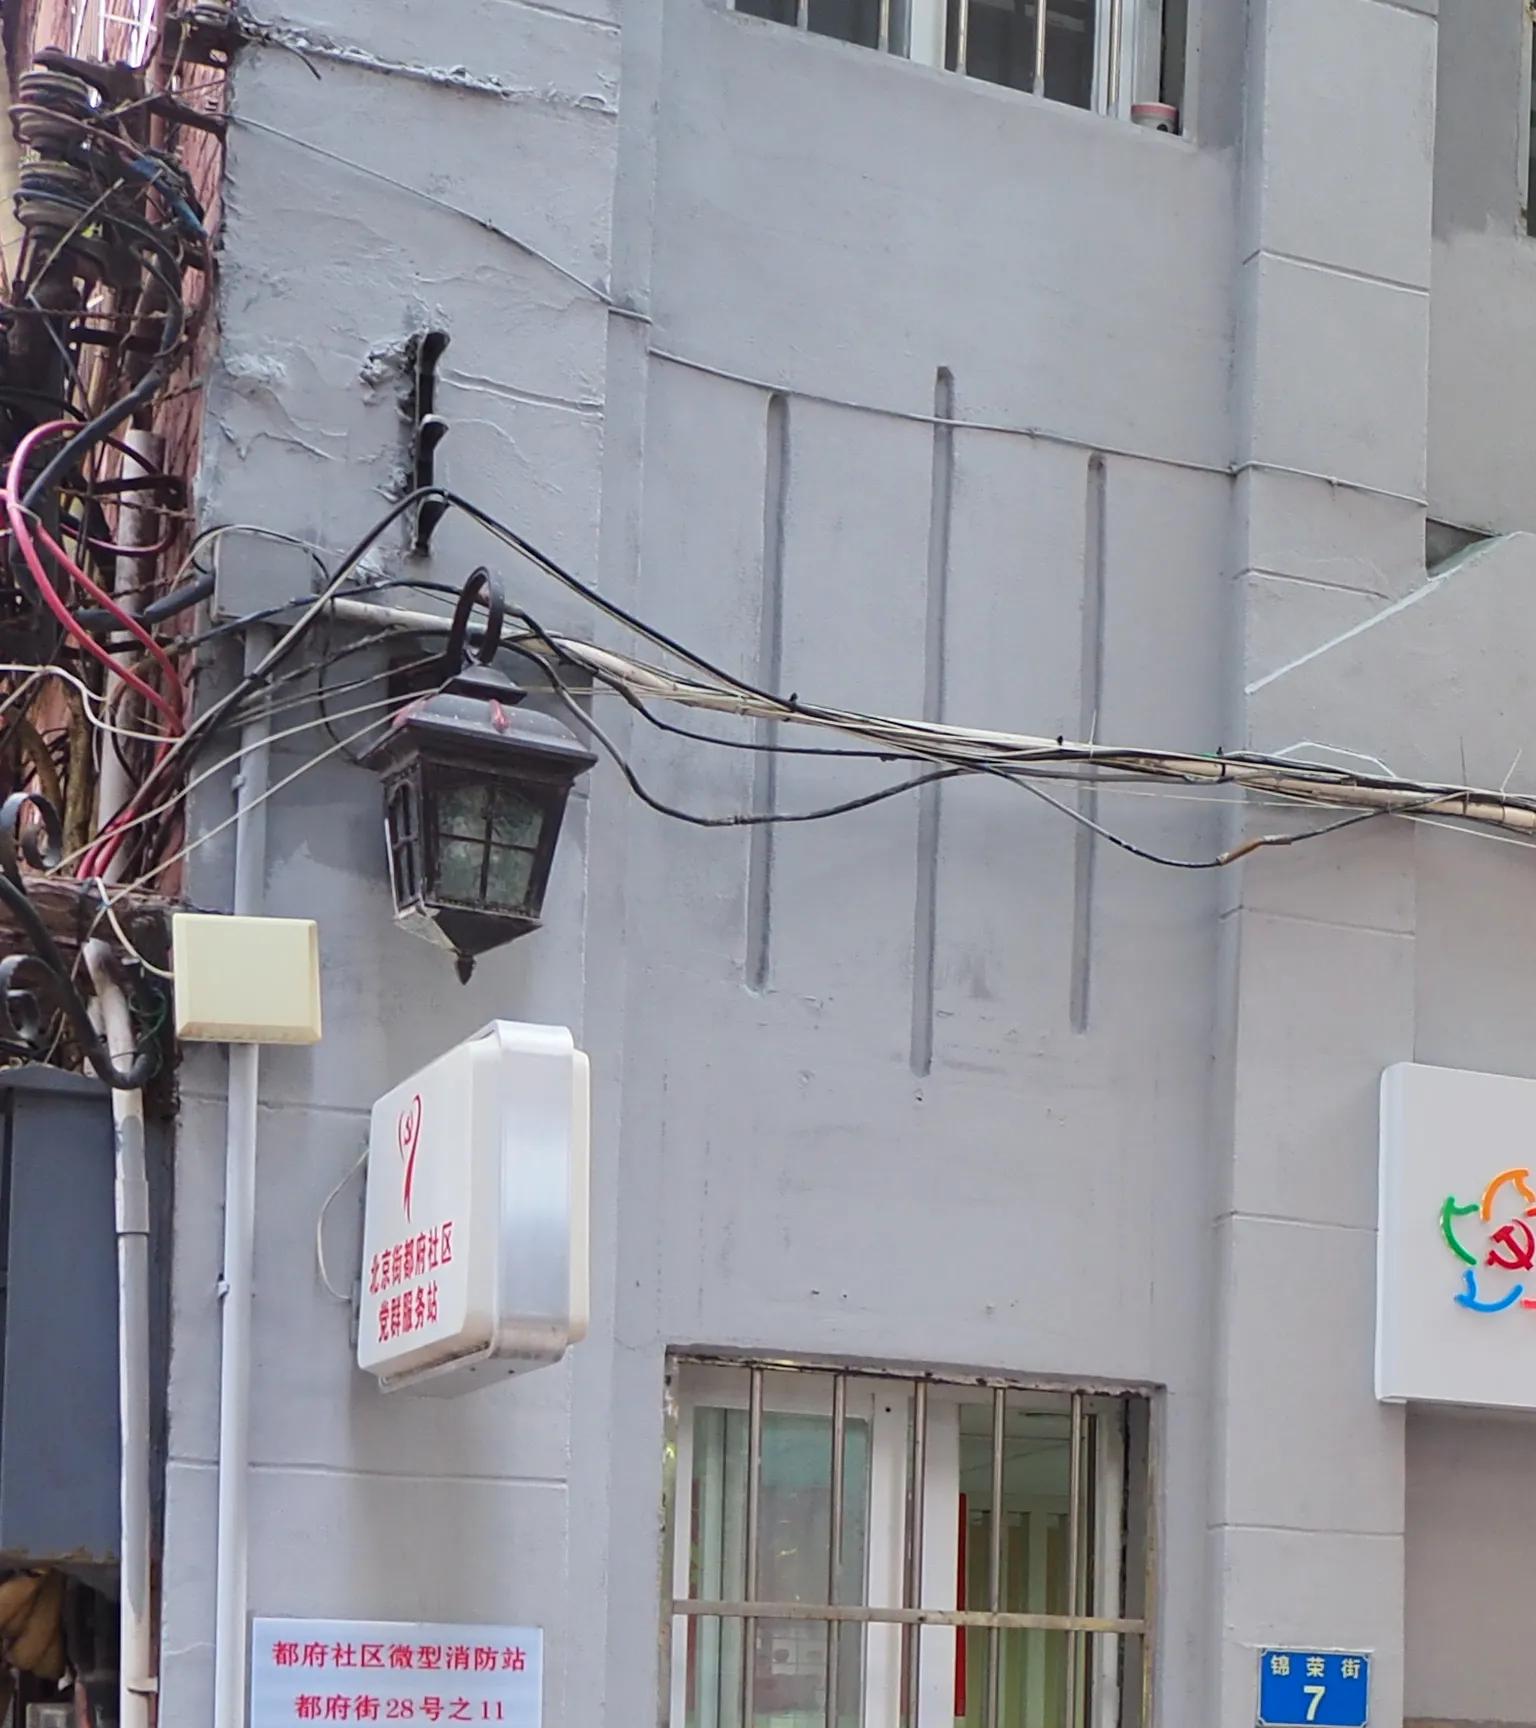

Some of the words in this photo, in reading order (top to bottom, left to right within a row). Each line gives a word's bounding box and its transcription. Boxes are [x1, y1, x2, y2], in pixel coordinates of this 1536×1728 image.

[369, 1221, 454, 1294] 北京街都府社区
[378, 1280, 439, 1343] 党群服务站
[272, 1640, 527, 1672] 都府社区微型消防站
[1270, 1655, 1361, 1679] 锦荣街
[295, 1693, 505, 1722] 都府街28号之11
[1303, 1685, 1326, 1722] 7
